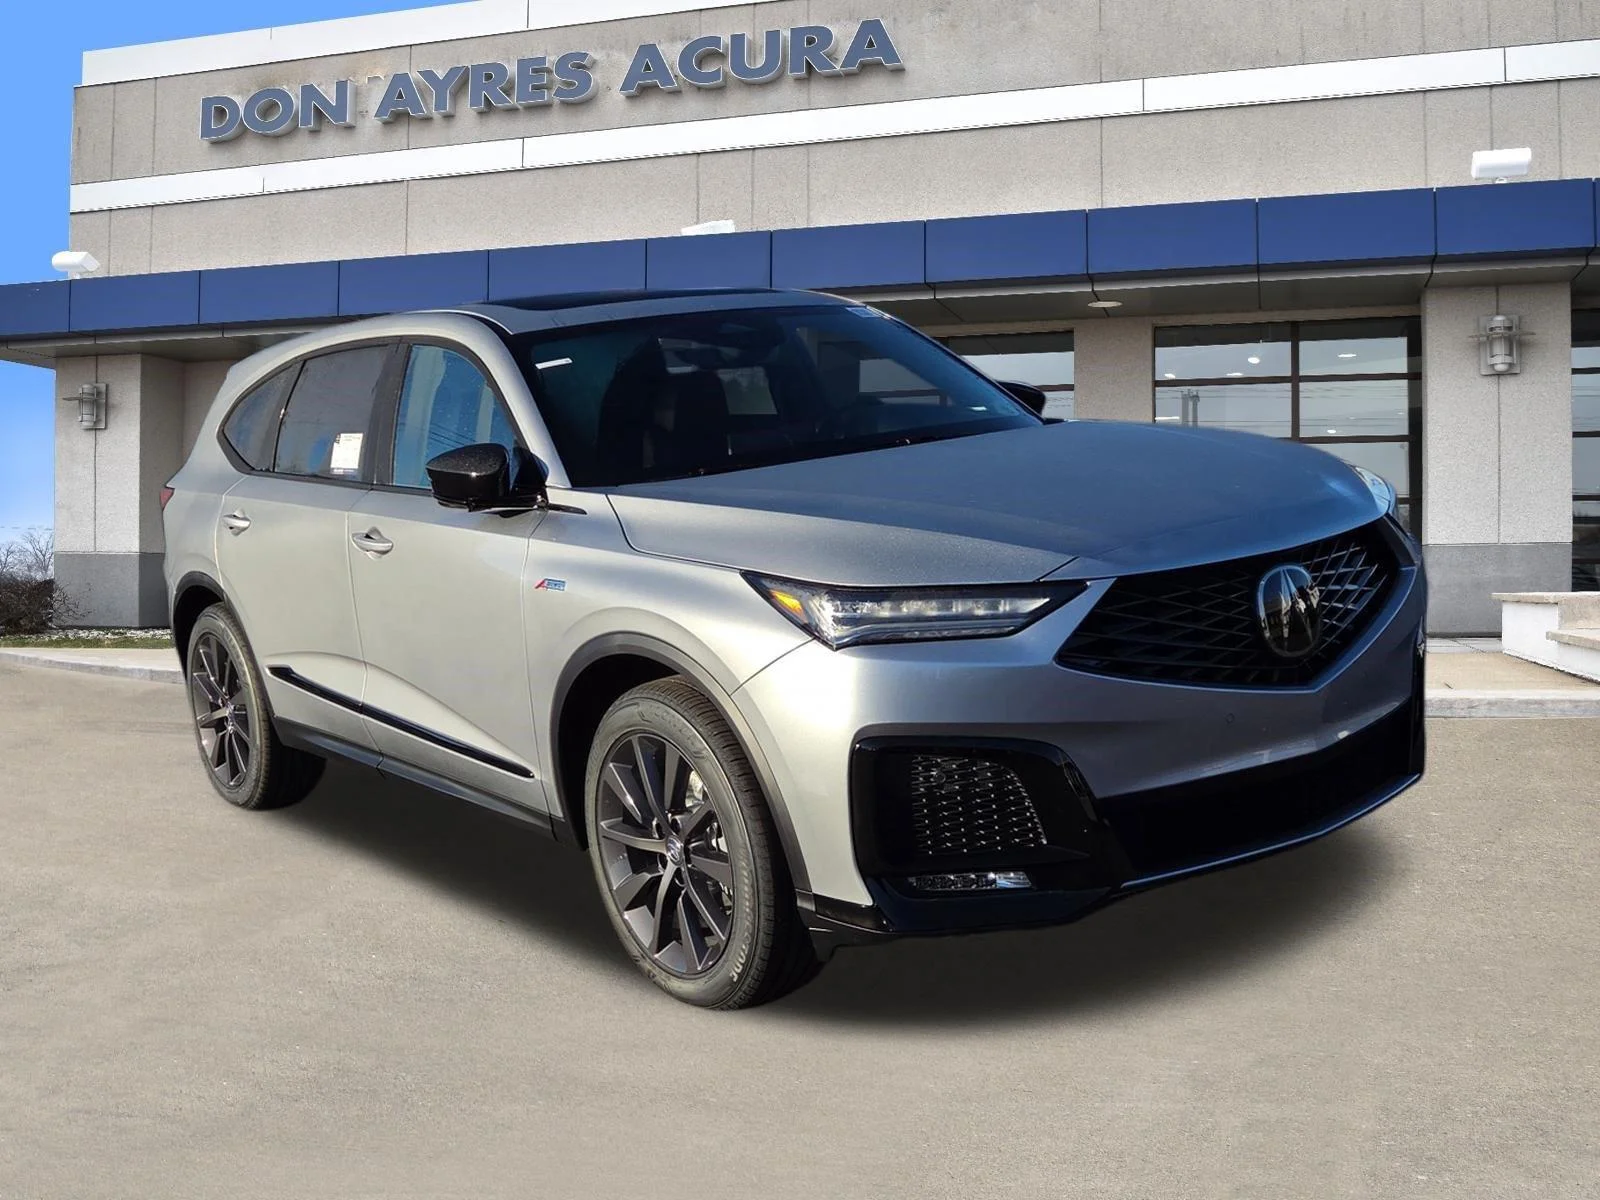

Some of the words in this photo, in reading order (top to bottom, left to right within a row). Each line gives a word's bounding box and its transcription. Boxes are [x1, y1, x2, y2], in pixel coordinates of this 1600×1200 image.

[200, 79, 354, 142] DON
[374, 51, 596, 121] AYRES
[619, 18, 905, 96] ACURA
